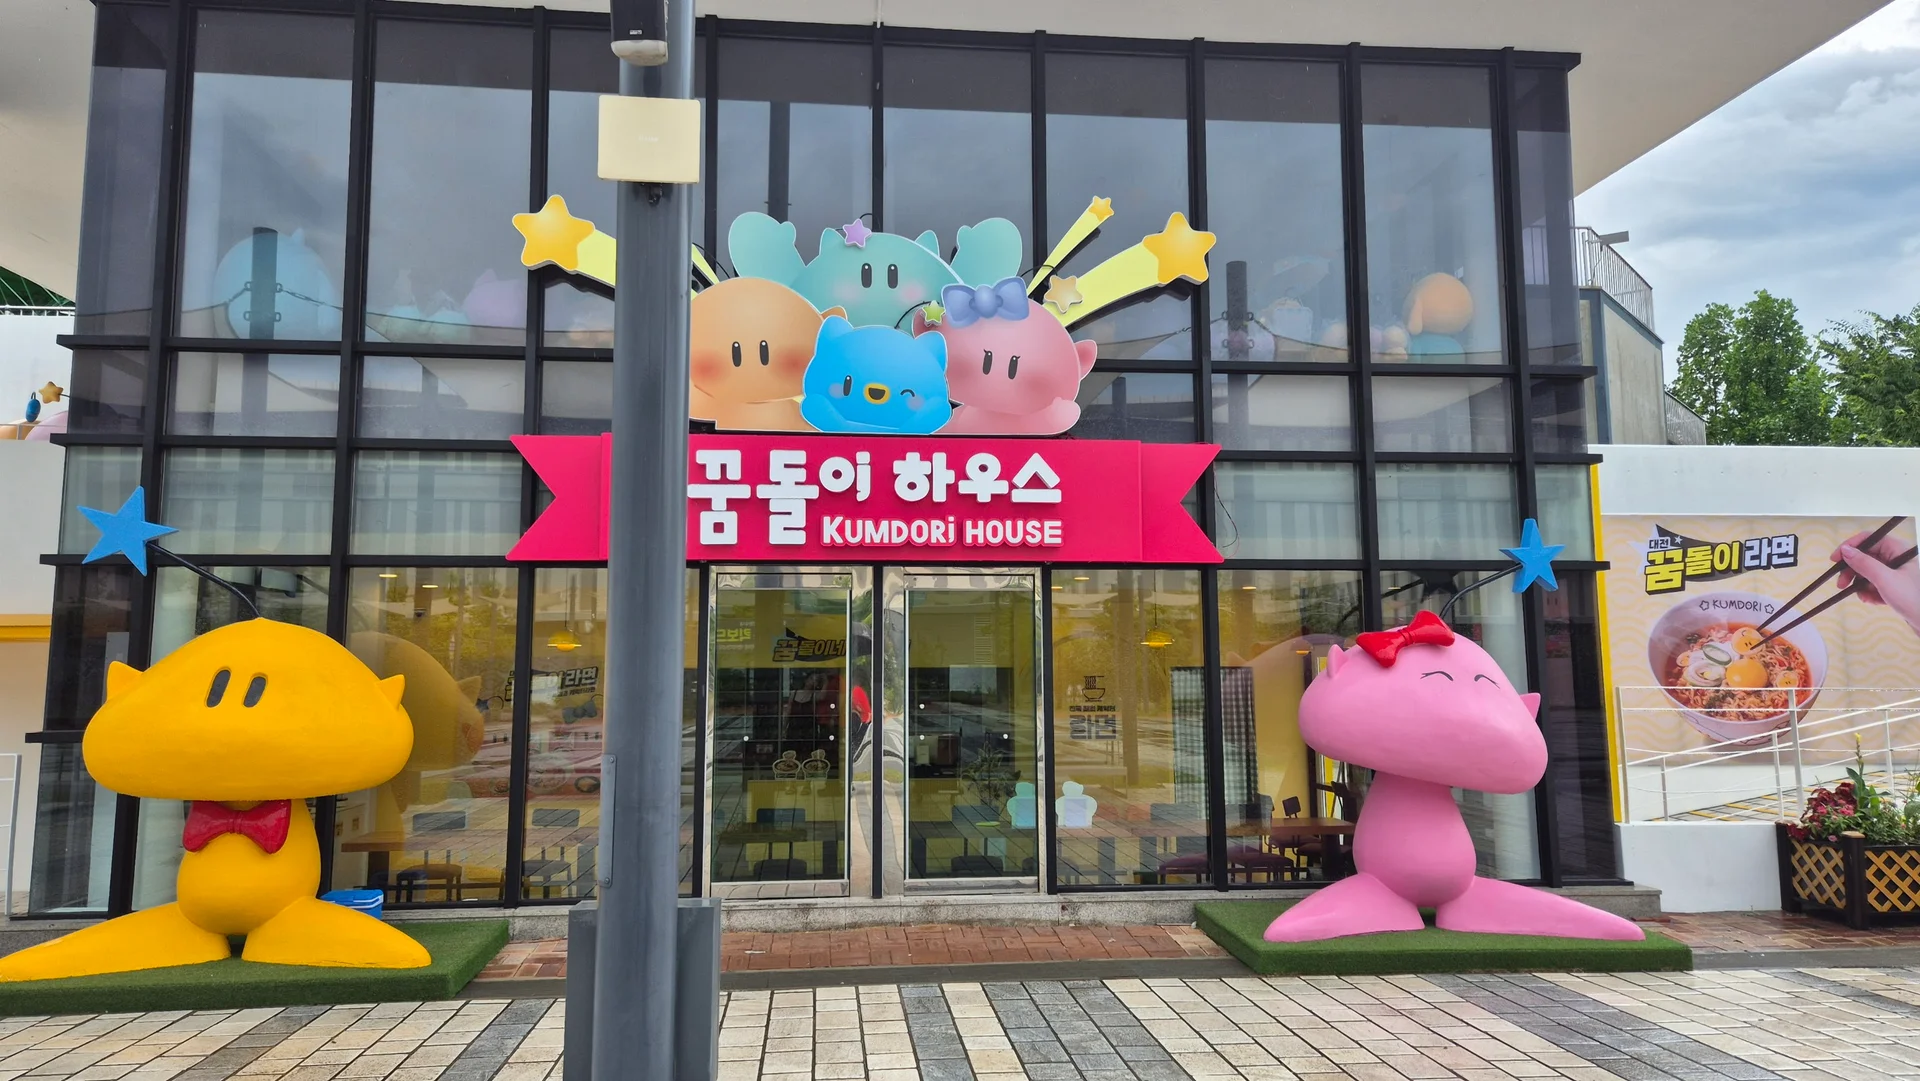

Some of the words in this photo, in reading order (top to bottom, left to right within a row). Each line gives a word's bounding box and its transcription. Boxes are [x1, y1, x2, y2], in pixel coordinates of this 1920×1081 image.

[687, 450, 871, 545] 꿈돌이
[893, 452, 1062, 503] 하우스
[965, 519, 1062, 544] HOUSE
[1648, 539, 1670, 550] 대전
[1645, 541, 1742, 594] 꿈돌이
[1744, 534, 1797, 570] 라면
[1712, 599, 1762, 612] KUMDORI
